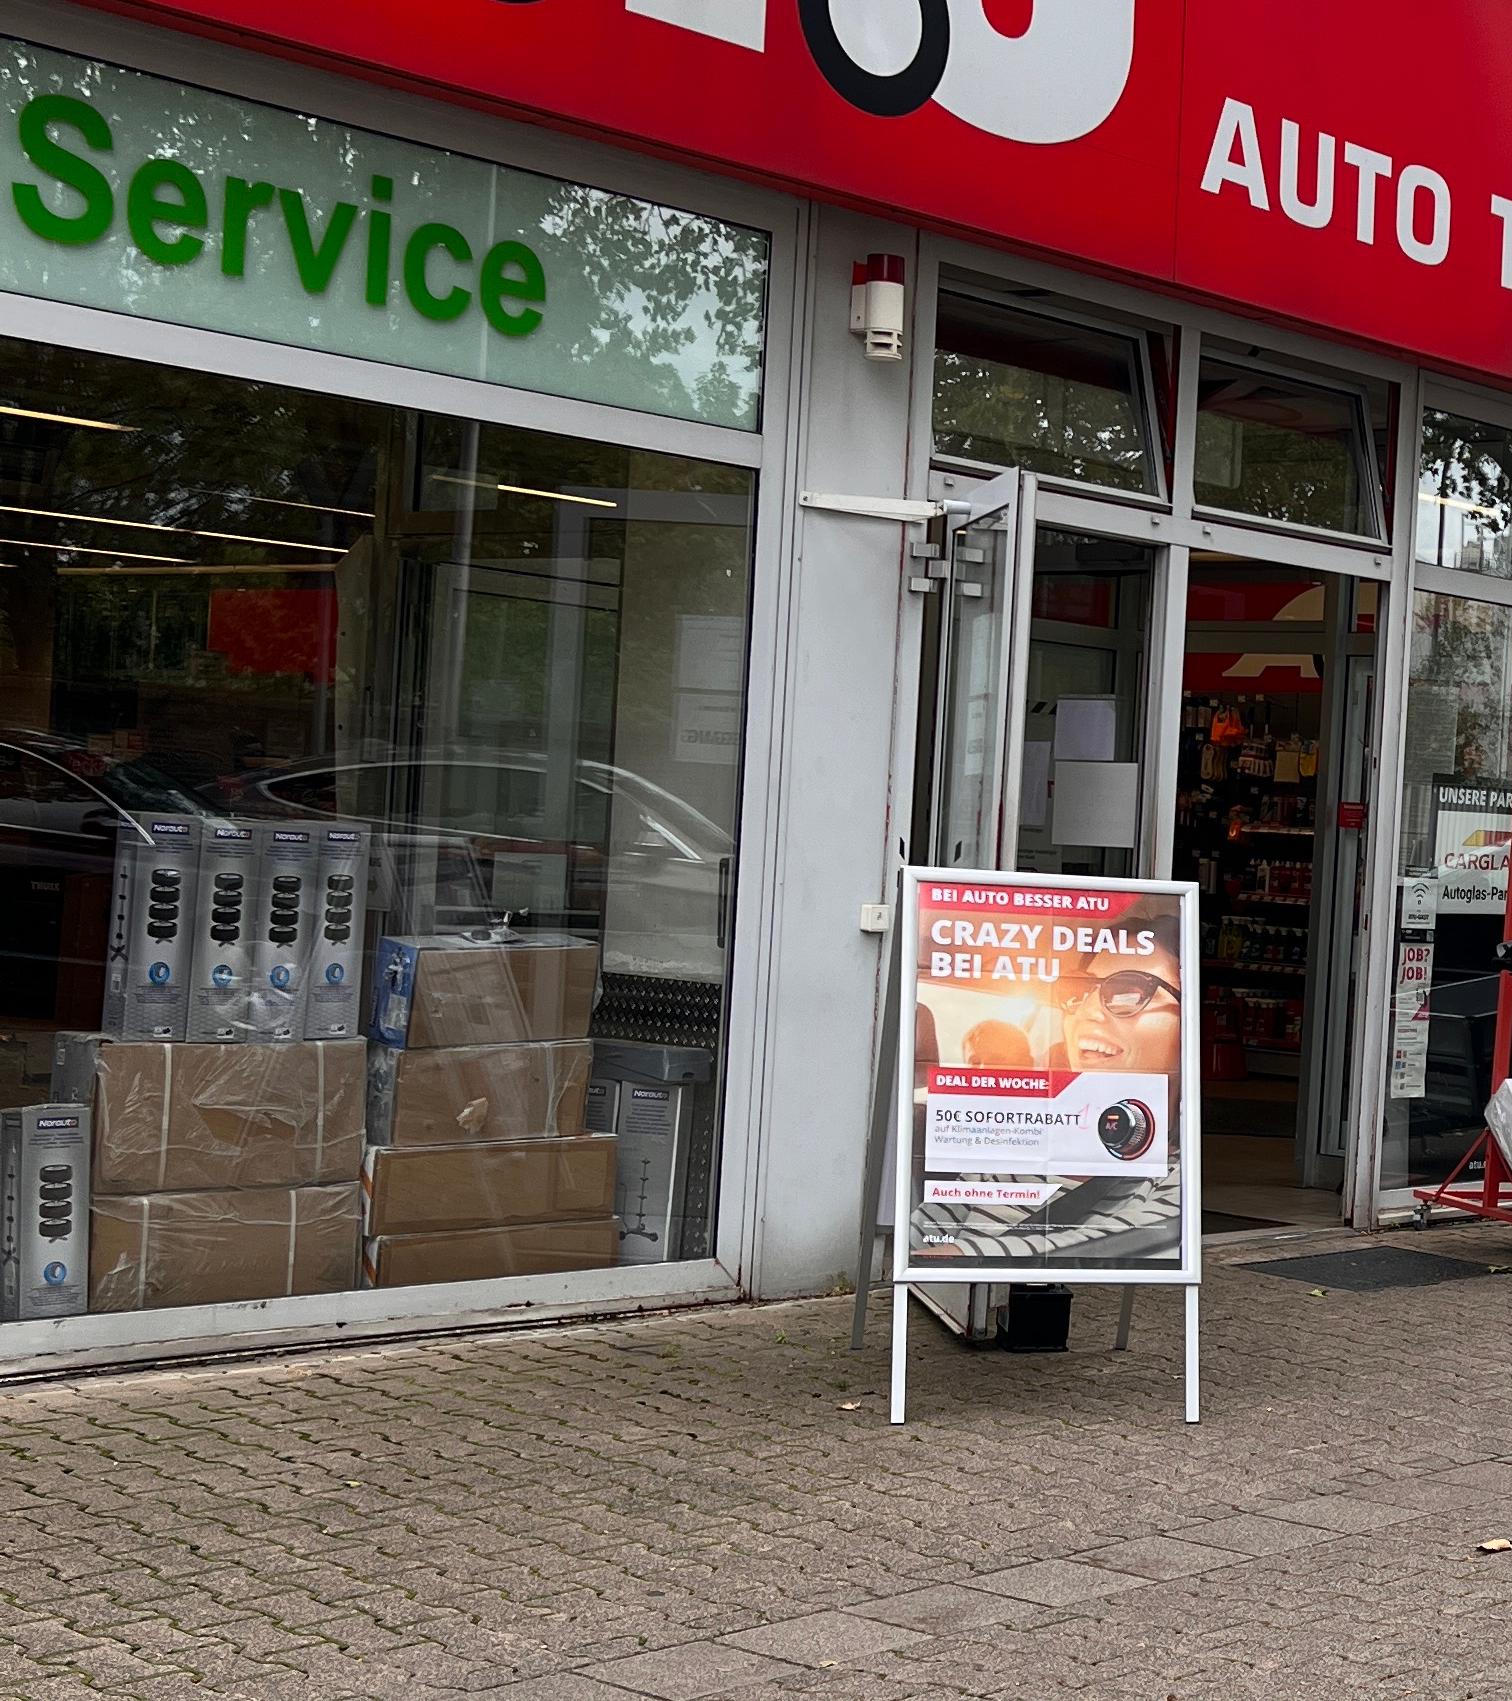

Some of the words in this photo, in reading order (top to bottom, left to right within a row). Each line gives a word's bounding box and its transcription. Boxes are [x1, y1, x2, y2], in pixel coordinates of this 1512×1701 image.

[1200, 96, 1451, 266] AUTO
[12, 93, 546, 336] Service
[1439, 786, 1486, 806] UNSERE
[153, 823, 189, 833] Norauto
[217, 829, 252, 839] Norauto
[932, 888, 958, 902] BEI
[962, 890, 1009, 906] AUTO
[1013, 893, 1073, 909] BESSER
[1076, 896, 1109, 911] ATU
[931, 919, 1043, 949] CRAZY
[1052, 926, 1155, 956] DEALS
[1402, 948, 1431, 966] JOB?
[931, 951, 982, 979] BEI
[991, 955, 1060, 982] ATU
[1400, 966, 1428, 984] JOB!
[936, 1074, 968, 1087] DEAL
[971, 1076, 996, 1088] DER
[38, 1118, 78, 1128] Norauto
[936, 1109, 962, 1123] 50€
[965, 1110, 1080, 1126] SOFORTRABATT
[934, 1124, 950, 1133] auf
[1105, 1121, 1119, 1130] A/C
[934, 1136, 973, 1147] Wartung
[975, 1137, 982, 1145] &
[984, 1137, 1040, 1147] Desinfektion
[932, 1187, 962, 1198] Auch
[964, 1189, 993, 1198] ohne
[997, 1189, 1041, 1199] Termin!
[922, 1234, 955, 1244] atu.de
